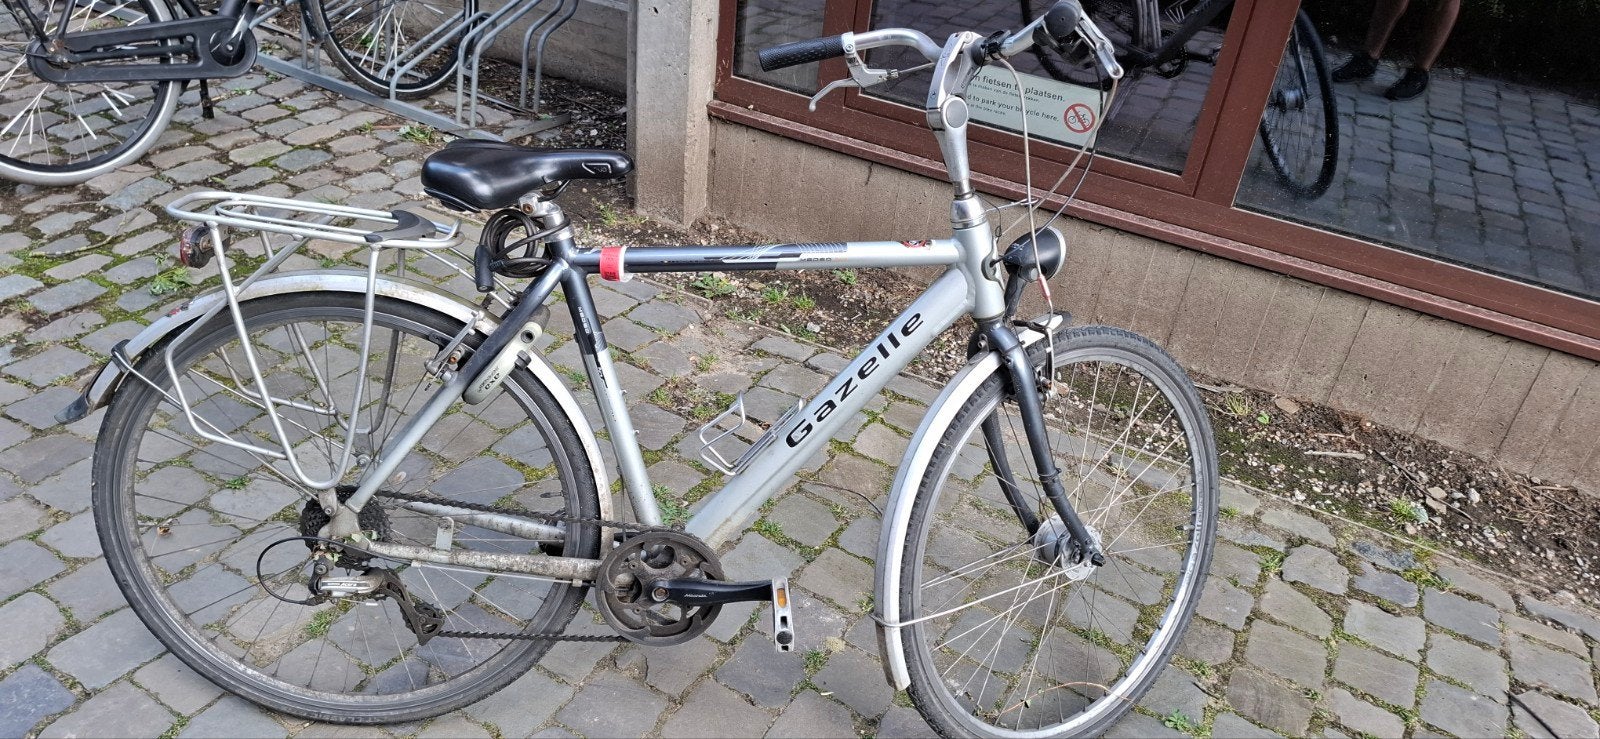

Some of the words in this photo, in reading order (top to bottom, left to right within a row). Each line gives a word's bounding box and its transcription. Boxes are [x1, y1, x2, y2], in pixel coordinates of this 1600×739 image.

[983, 75, 1012, 89] fietsen
[1025, 87, 1065, 101] plaatsen.
[981, 97, 996, 106] park
[1041, 112, 1060, 122] here.
[785, 312, 924, 448] Gazelle
